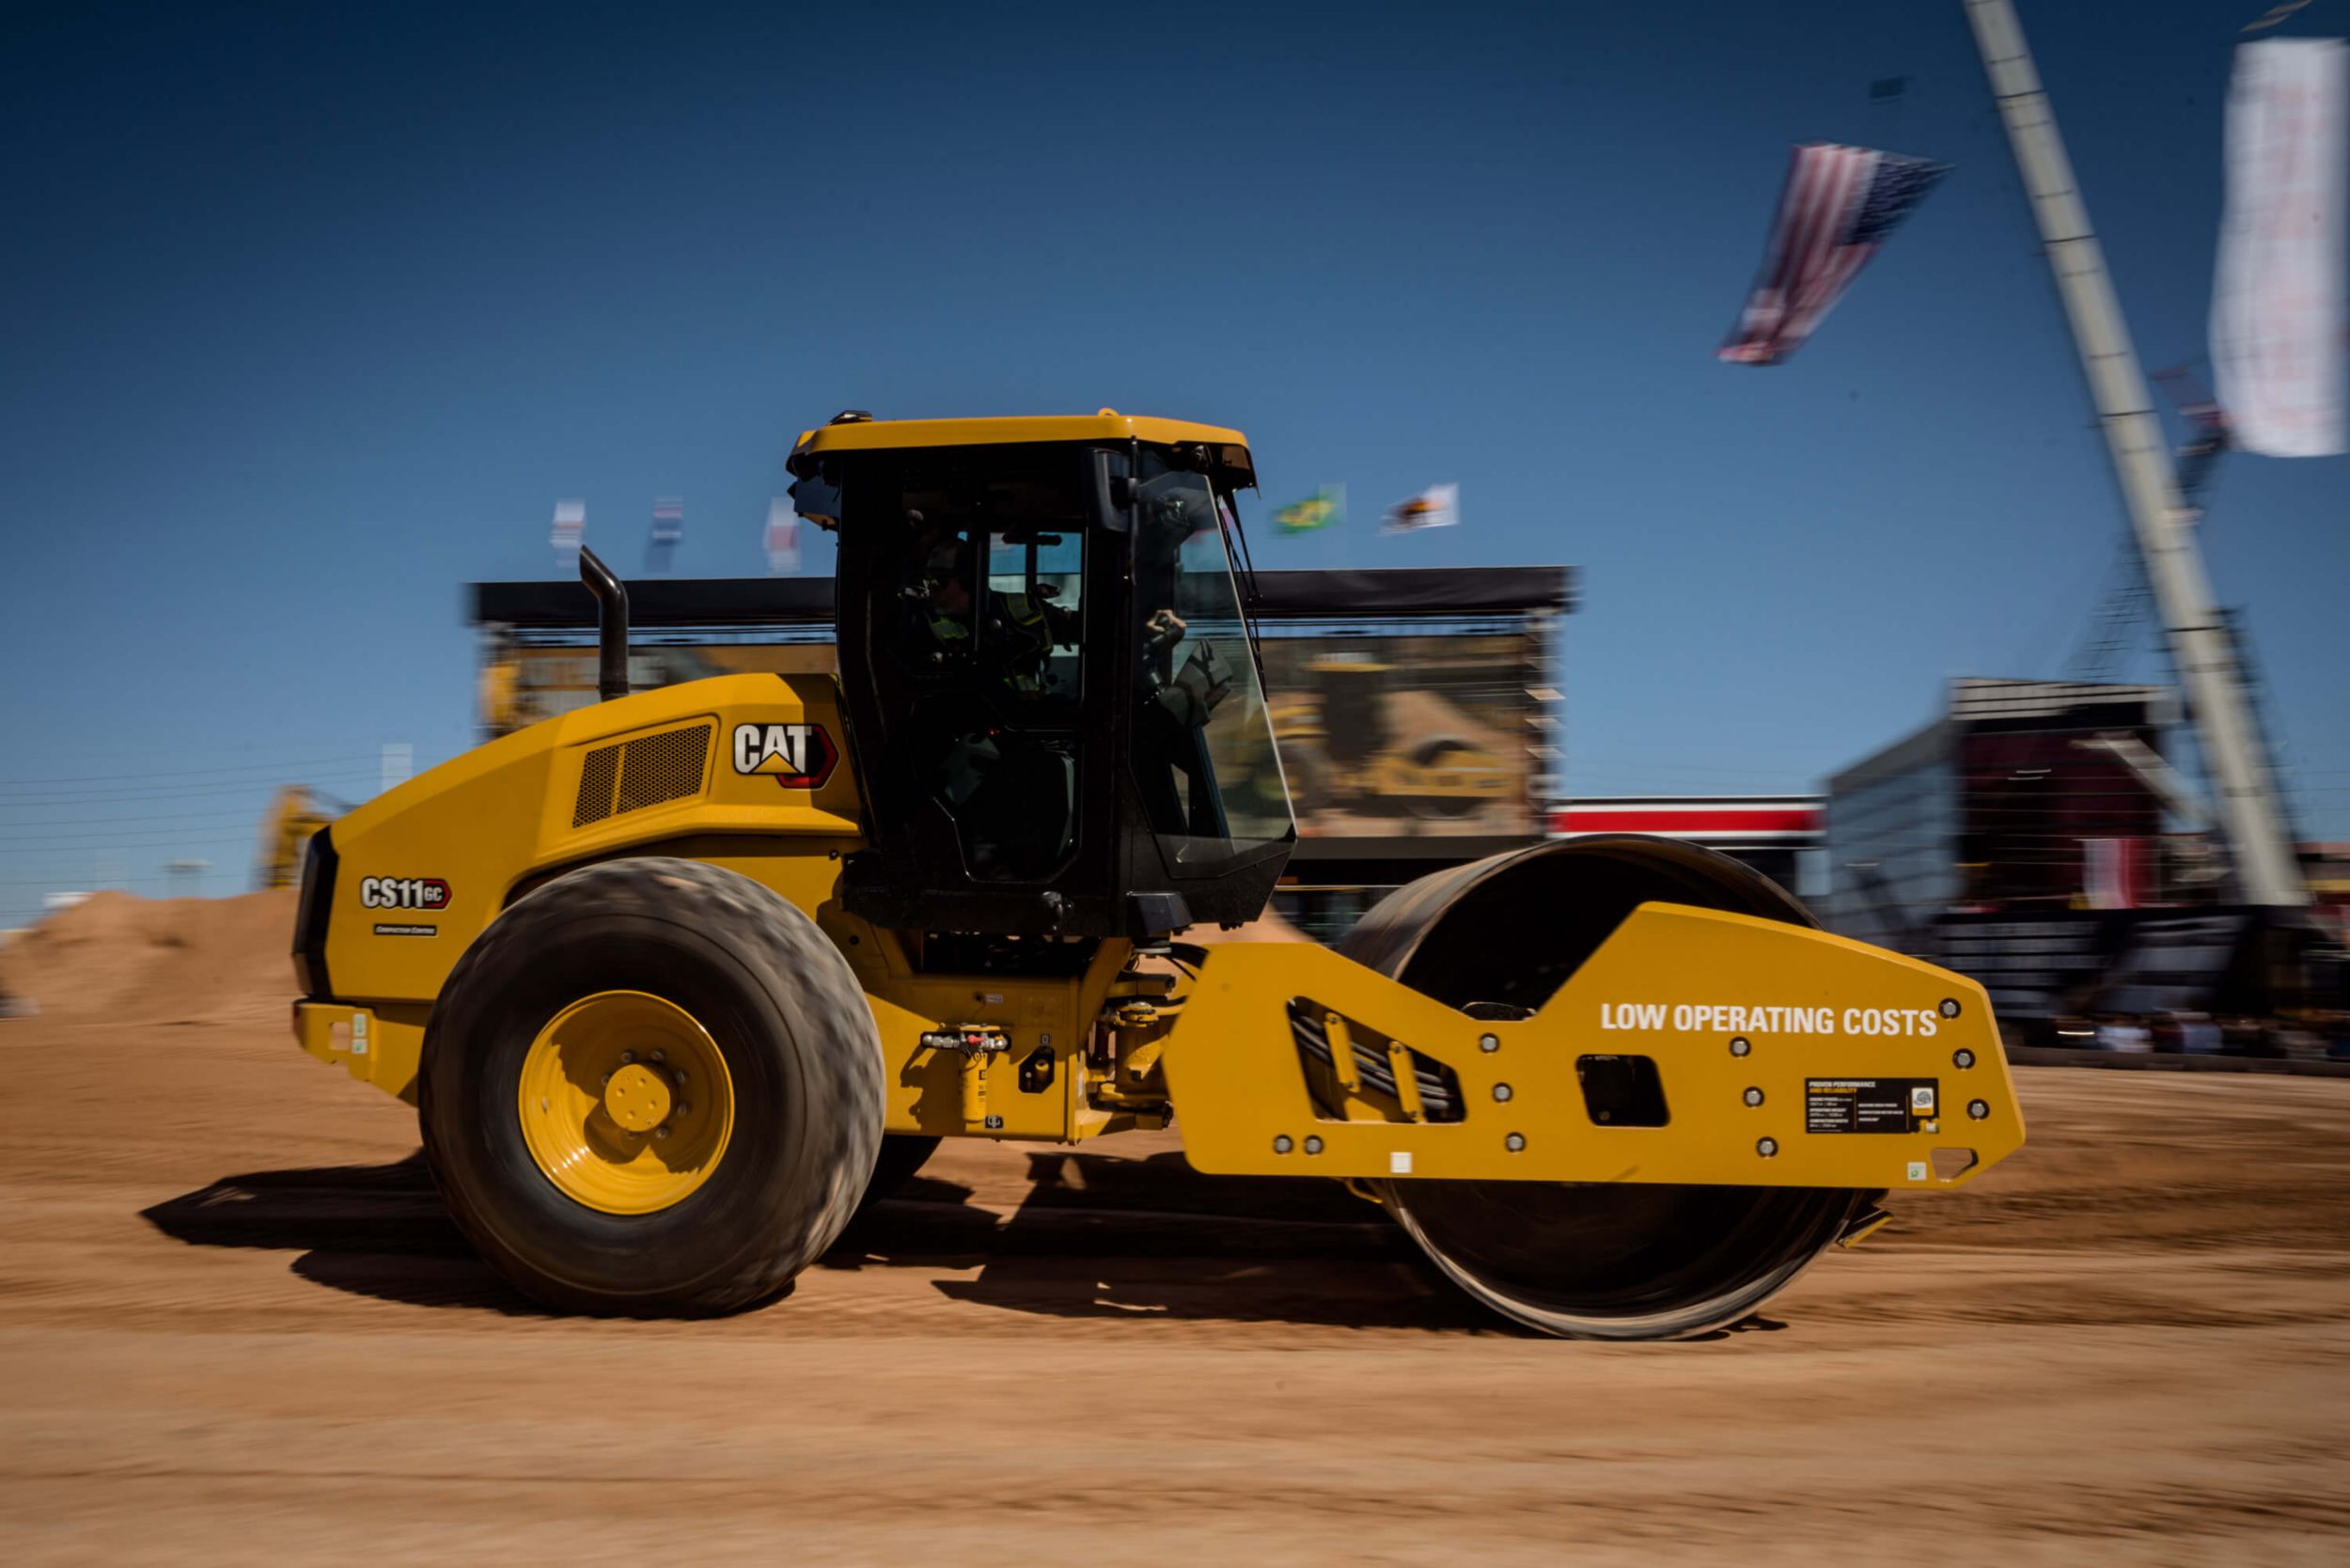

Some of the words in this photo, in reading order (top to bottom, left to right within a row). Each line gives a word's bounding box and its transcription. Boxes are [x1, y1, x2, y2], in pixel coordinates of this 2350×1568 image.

[735, 725, 812, 774] CAT
[362, 877, 423, 908] CS11
[1601, 1003, 1668, 1030] LOW
[1673, 1004, 1835, 1034] OPERATING
[1843, 1008, 1937, 1036] COSTS
